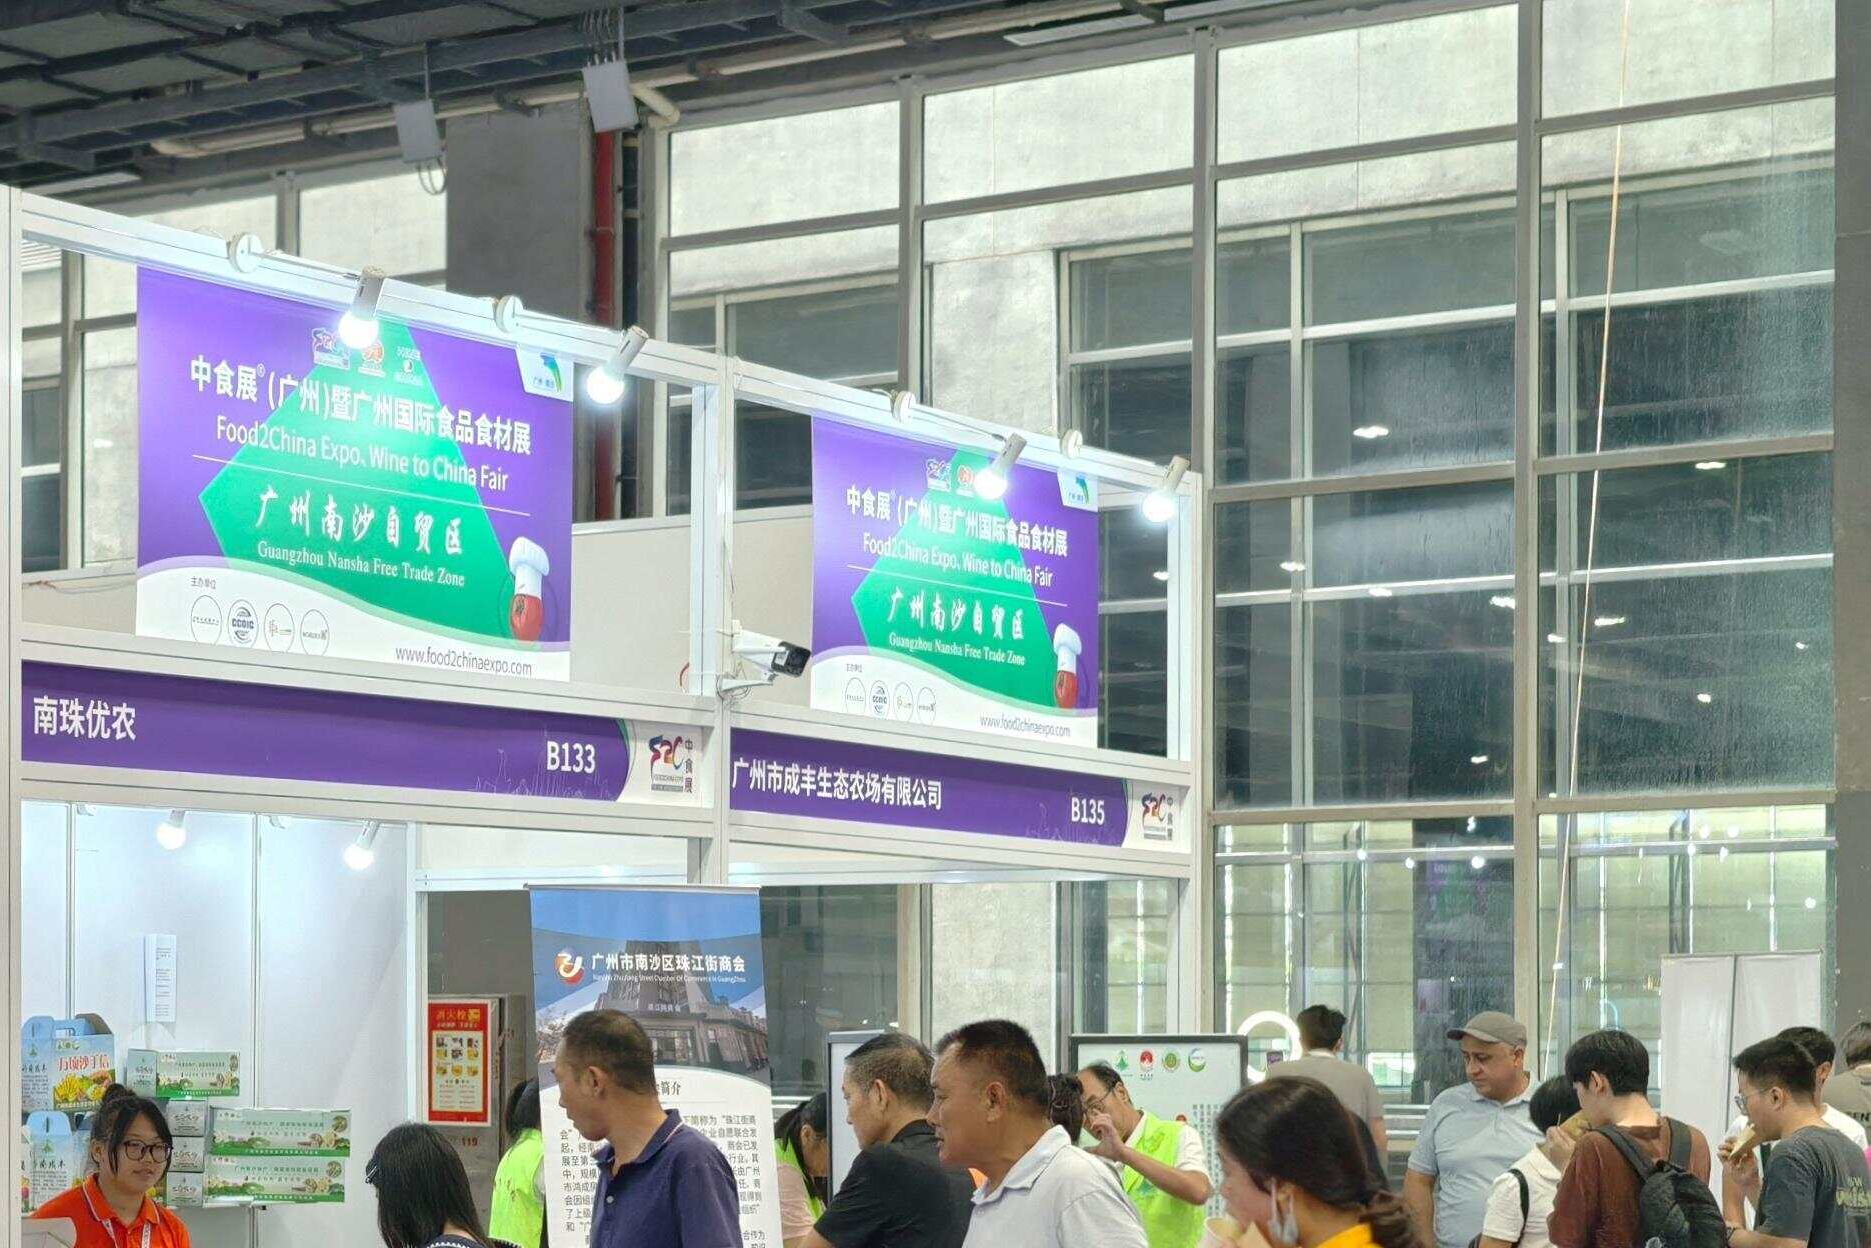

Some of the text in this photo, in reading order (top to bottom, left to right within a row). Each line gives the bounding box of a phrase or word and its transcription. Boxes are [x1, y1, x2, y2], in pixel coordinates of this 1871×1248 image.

[216, 415, 317, 459] Food2China
[368, 446, 409, 475] Wine
[413, 456, 429, 478] to
[433, 455, 477, 487] China
[480, 465, 509, 493] Fair
[255, 484, 463, 557] 广州南沙自贸区
[257, 539, 465, 588] Guangzhou Nansha Free Trade Zone
[863, 531, 929, 564] Food2China
[962, 552, 989, 574] Wine
[990, 559, 1002, 577] to
[1004, 561, 1033, 584] China
[1034, 566, 1053, 587] Fair
[887, 586, 1025, 640] 广州南沙自贸区
[395, 645, 533, 677] www.food2chinaexpo.com
[888, 631, 1026, 666] Guangzhou Nansha Free Trade Zone
[33, 694, 137, 742] 南珠优农
[979, 713, 1071, 738] www.food2chinaexpo.com
[545, 739, 597, 774] B133
[732, 757, 943, 812] 广州市成丰生态农场有限公司
[1070, 796, 1106, 827] B135
[591, 952, 746, 973] 广州市南沙区珠江街商会
